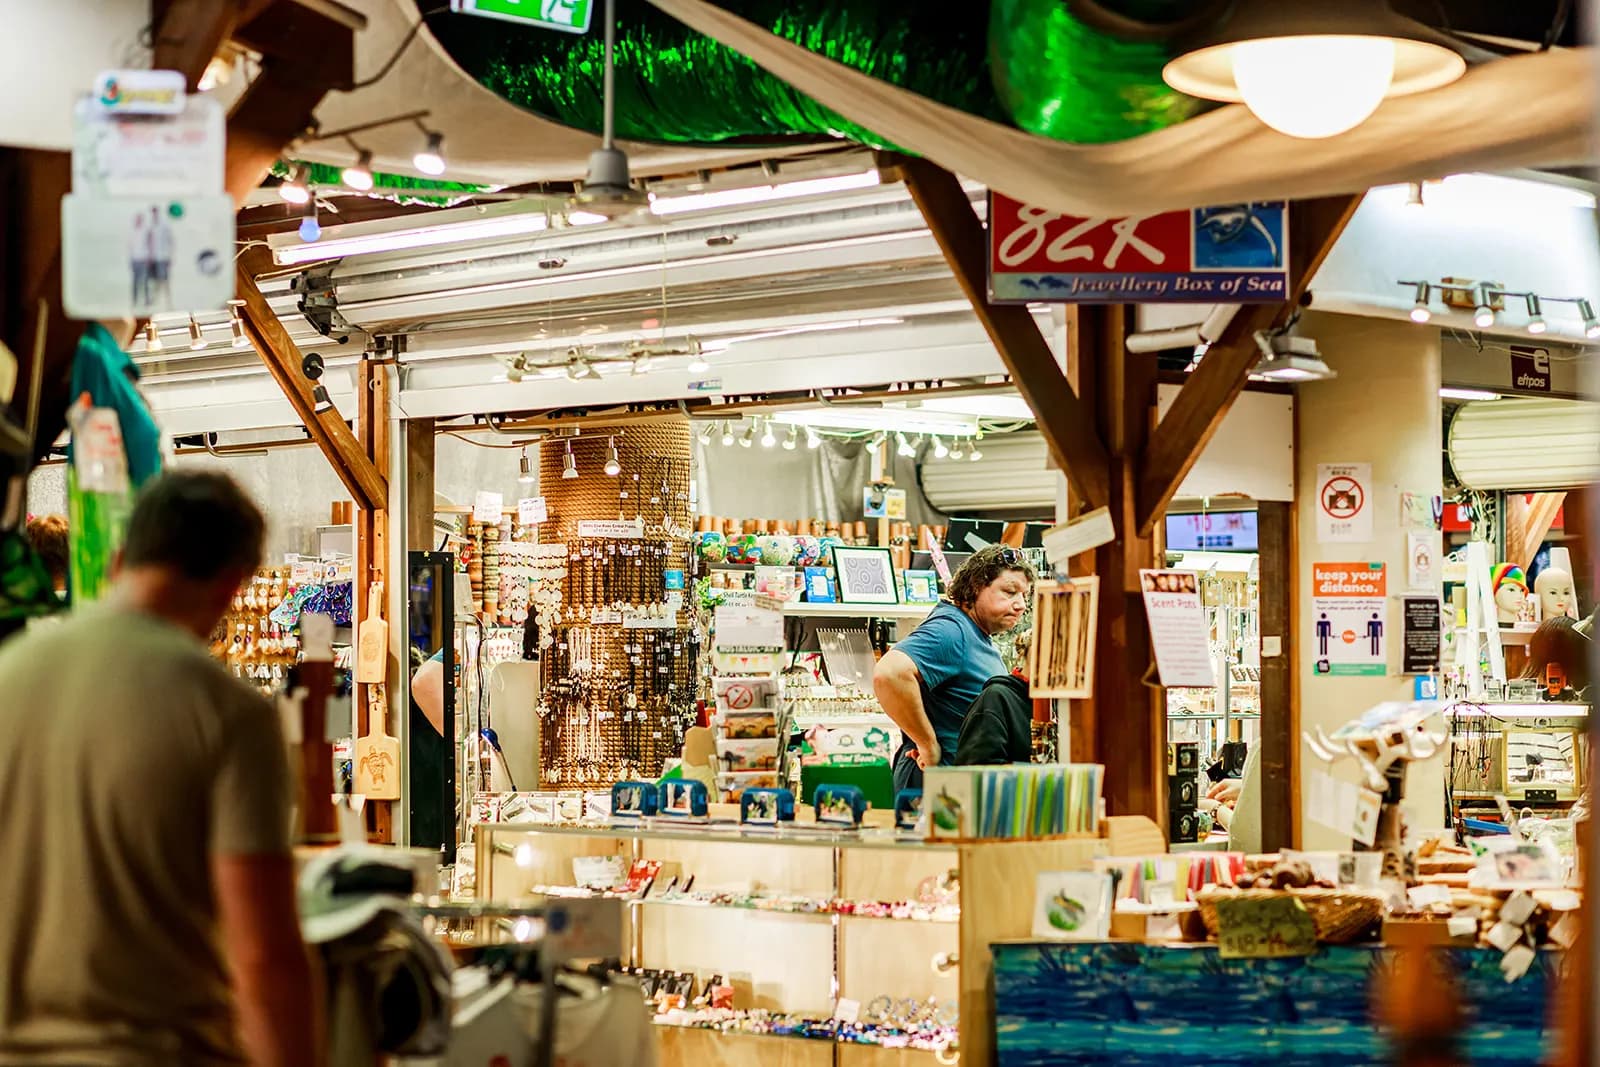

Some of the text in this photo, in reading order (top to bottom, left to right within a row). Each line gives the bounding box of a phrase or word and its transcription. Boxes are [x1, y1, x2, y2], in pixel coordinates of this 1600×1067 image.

[1071, 275, 1284, 295] Jewellery Box of Sea
[1517, 373, 1546, 388] eftpos
[1315, 568, 1383, 585] keep your
[1319, 581, 1379, 593] distance.
